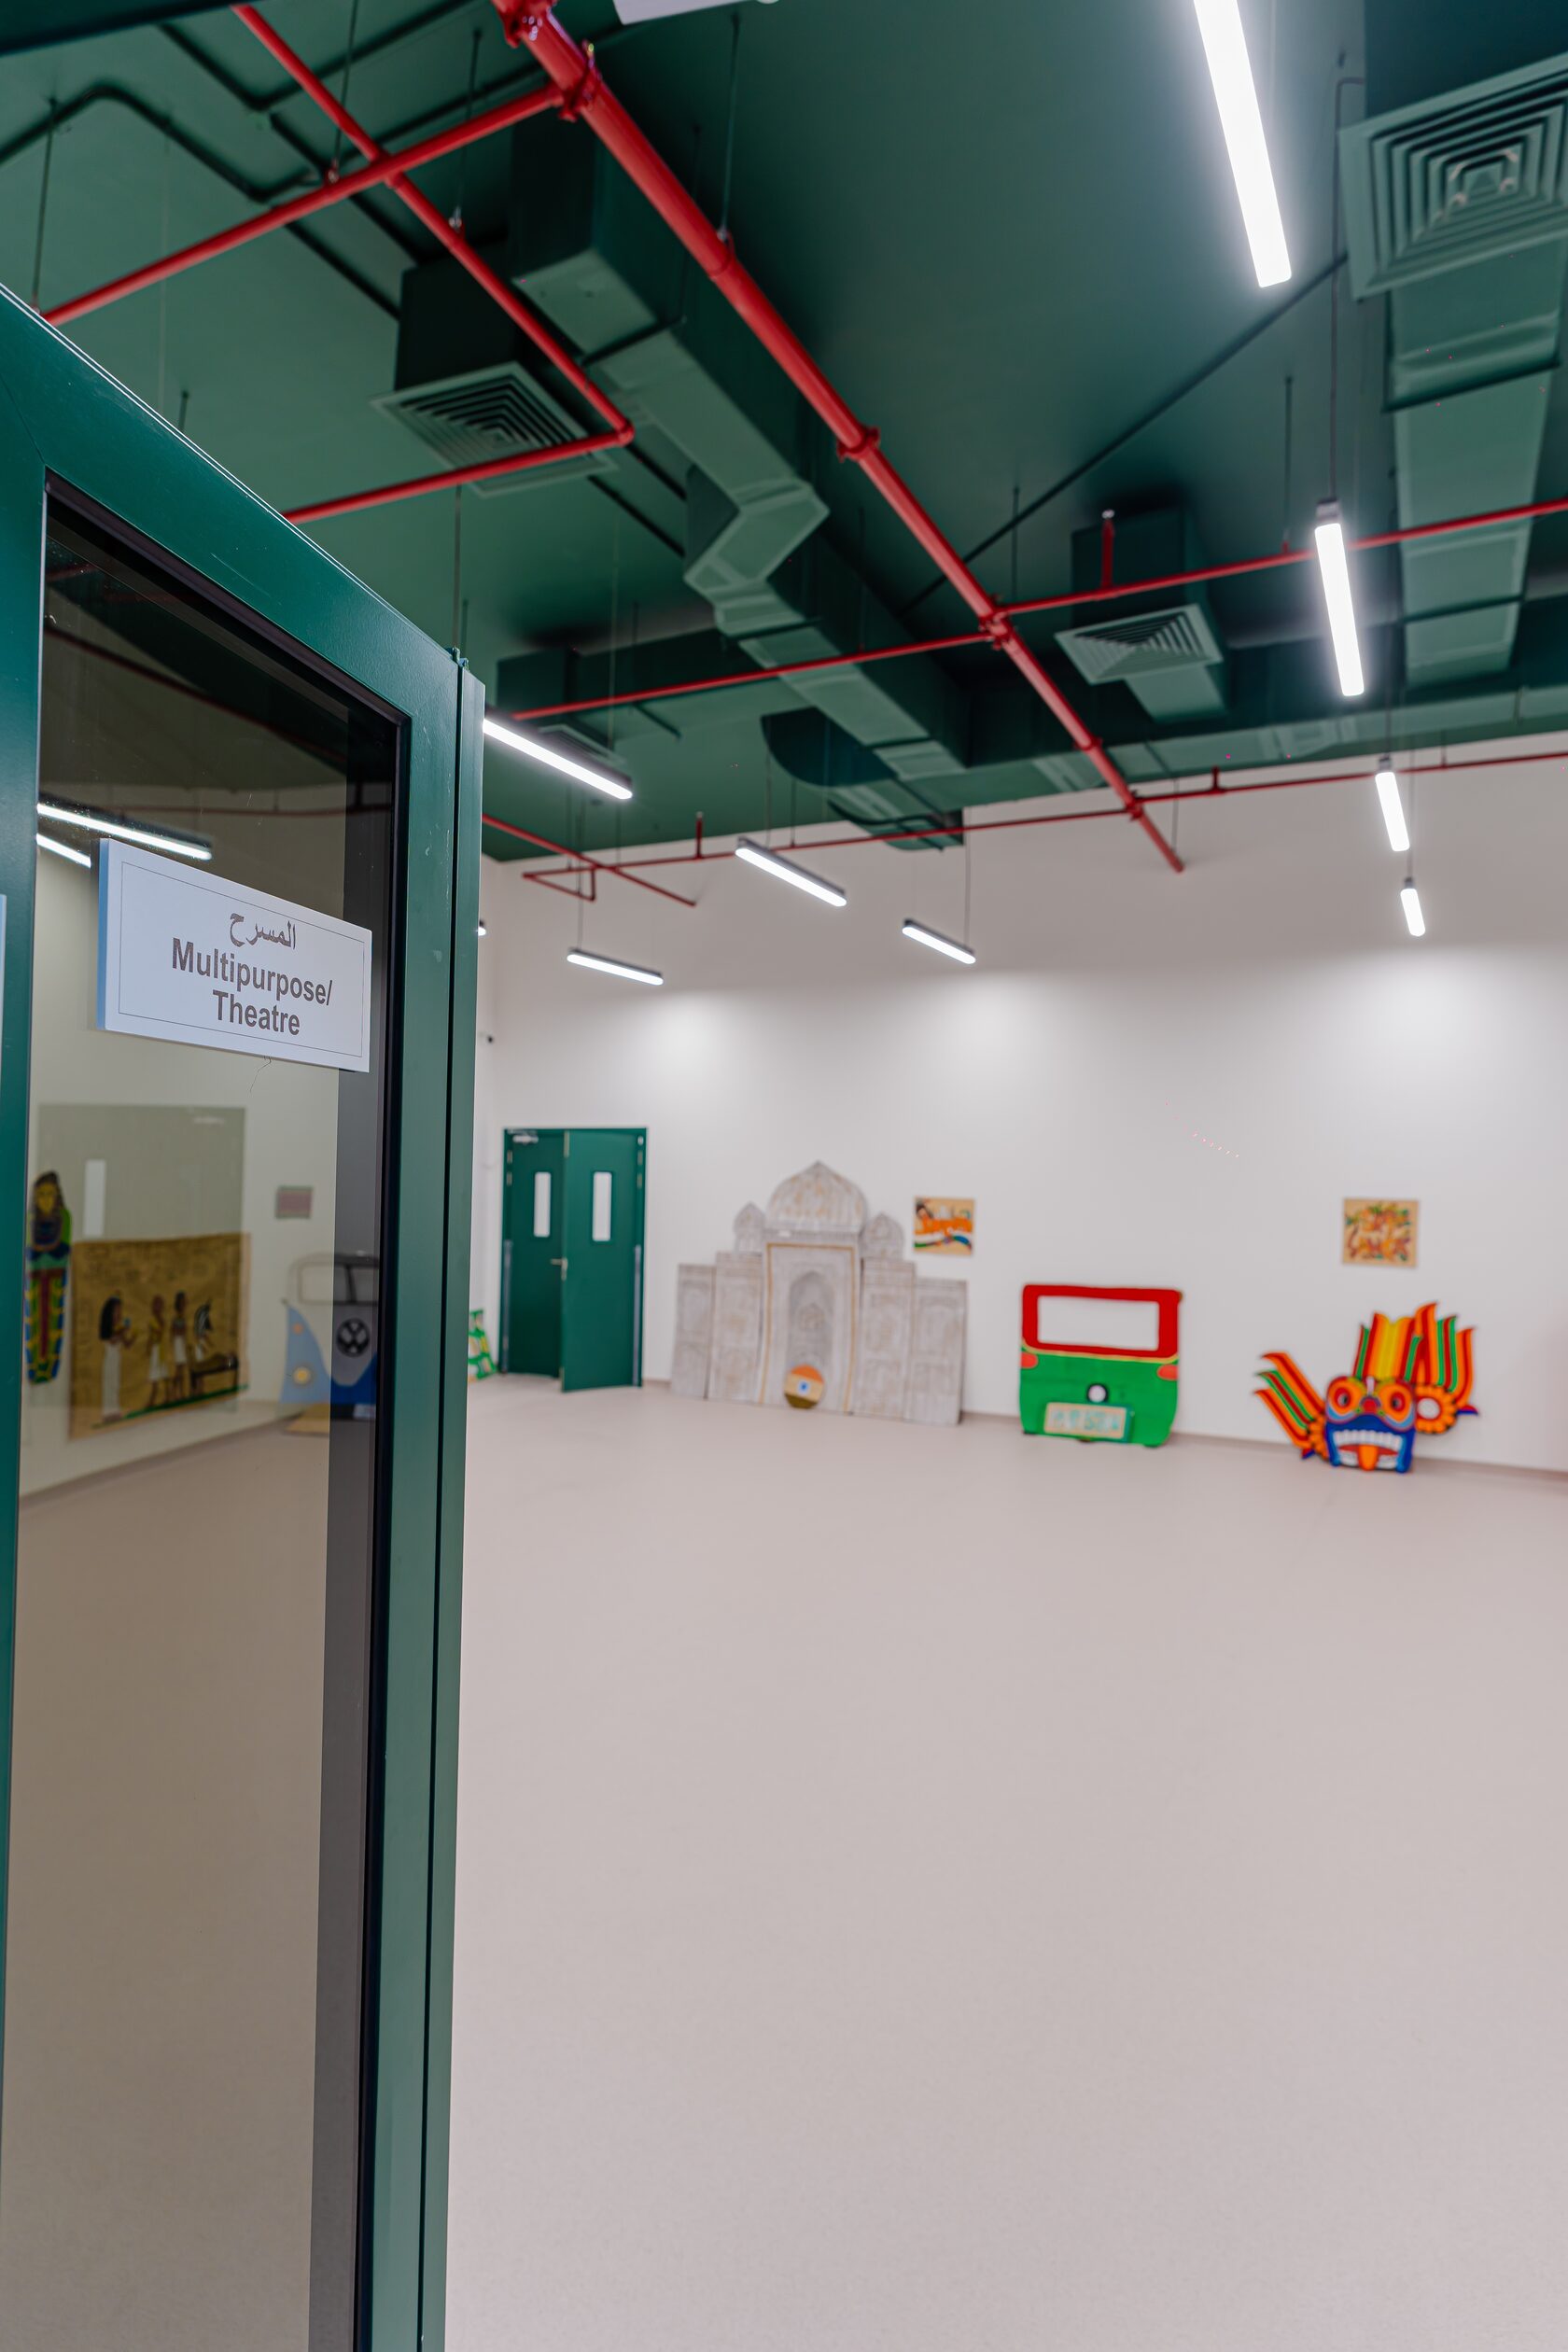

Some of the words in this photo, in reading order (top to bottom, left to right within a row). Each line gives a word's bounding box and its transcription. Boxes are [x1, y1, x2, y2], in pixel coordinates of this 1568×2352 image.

[230, 913, 296, 950] المسرح
[172, 937, 332, 1005] Multipurpose/
[212, 989, 300, 1036] Theatre
